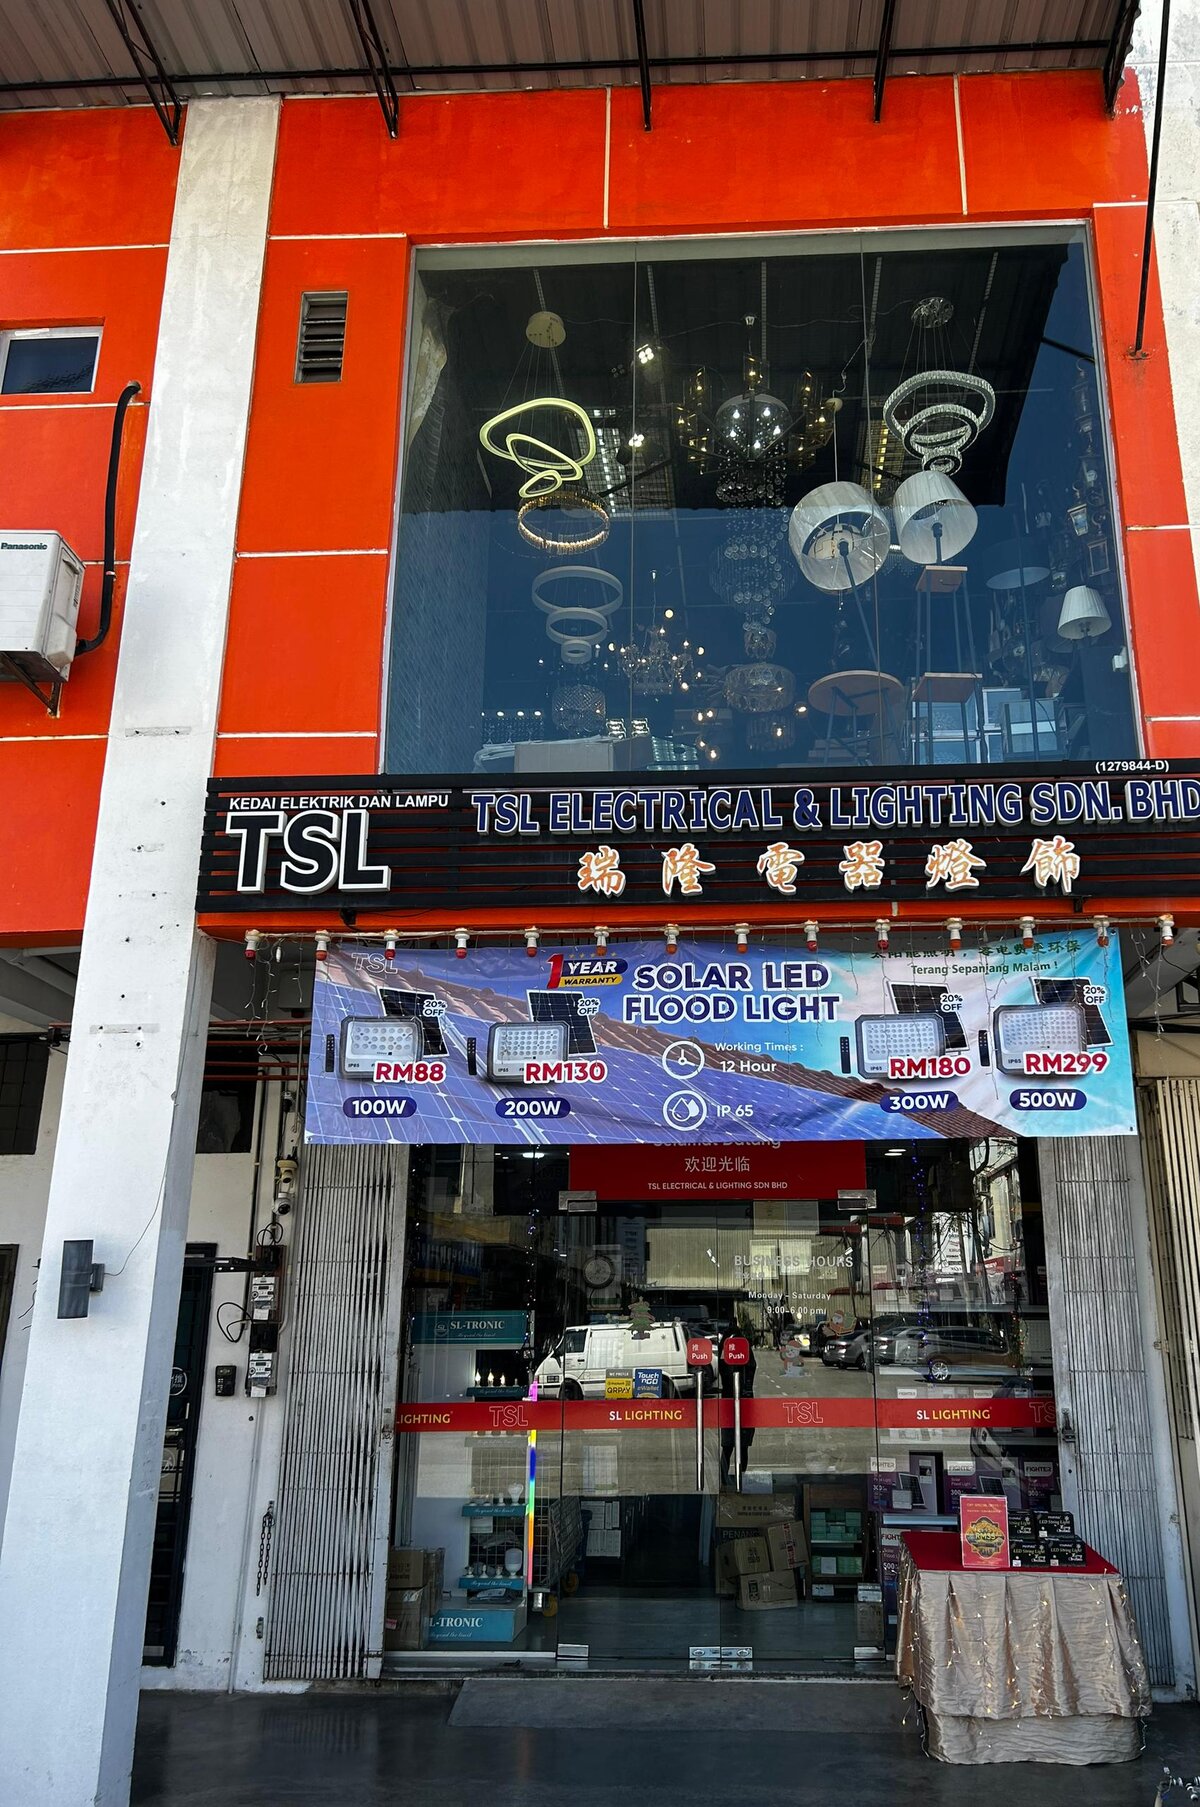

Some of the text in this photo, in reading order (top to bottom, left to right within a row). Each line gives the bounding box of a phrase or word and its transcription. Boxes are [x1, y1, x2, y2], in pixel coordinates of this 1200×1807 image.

[1095, 760, 1169, 773] (1279844-D)
[229, 794, 449, 810] KEDAI ELEKTRIK DAN LAMPU
[471, 779, 1200, 836] TSL ELECTRICAL & LIGHTING SDN. BHD
[225, 809, 392, 895] TSL
[577, 834, 1082, 897] 瑞隆電器燈飾
[352, 953, 398, 974] TSL
[567, 961, 618, 975] YEAR
[912, 965, 949, 976] Terang
[952, 963, 1009, 976] Sepanjang
[1012, 962, 1050, 973] Malam
[546, 953, 564, 989] 1
[634, 962, 831, 990] SOLAR LED
[564, 976, 618, 986] WARRANTY
[1085, 986, 1105, 995] 20%
[941, 994, 963, 1003] 20%
[1085, 995, 1104, 1004] OFF
[424, 1008, 444, 1016] OFF
[624, 994, 841, 1022] FLOOD LIGHT
[942, 1003, 963, 1012] OFF
[715, 1042, 760, 1053] Working
[764, 1042, 797, 1052] Times
[720, 1060, 777, 1072] 12 Hour
[889, 1057, 971, 1077] RM180
[1025, 1053, 1108, 1072] RM299
[375, 1062, 445, 1081] RM88
[525, 1062, 606, 1081] RM130
[889, 1094, 951, 1110] 300W
[1018, 1091, 1077, 1108] 500W
[352, 1099, 407, 1115] 100W
[504, 1100, 561, 1116] 200W
[716, 1105, 754, 1117] IP 65
[684, 1156, 750, 1172] 欢迎光临
[663, 1182, 707, 1190] ELECTRICAL
[734, 1255, 854, 1268] BUSINESS HOURS
[749, 1292, 783, 1301] Monday
[792, 1292, 831, 1301] Saturday
[450, 1321, 505, 1329] SL-TRONIC
[397, 1414, 450, 1424] IGHTING
[489, 1405, 528, 1427] TSL
[609, 1410, 682, 1420] SL LIGHTING
[782, 1402, 823, 1423] TSL
[916, 1410, 990, 1420] SL LIGHTING
[430, 1618, 484, 1627] L-TRONIC
